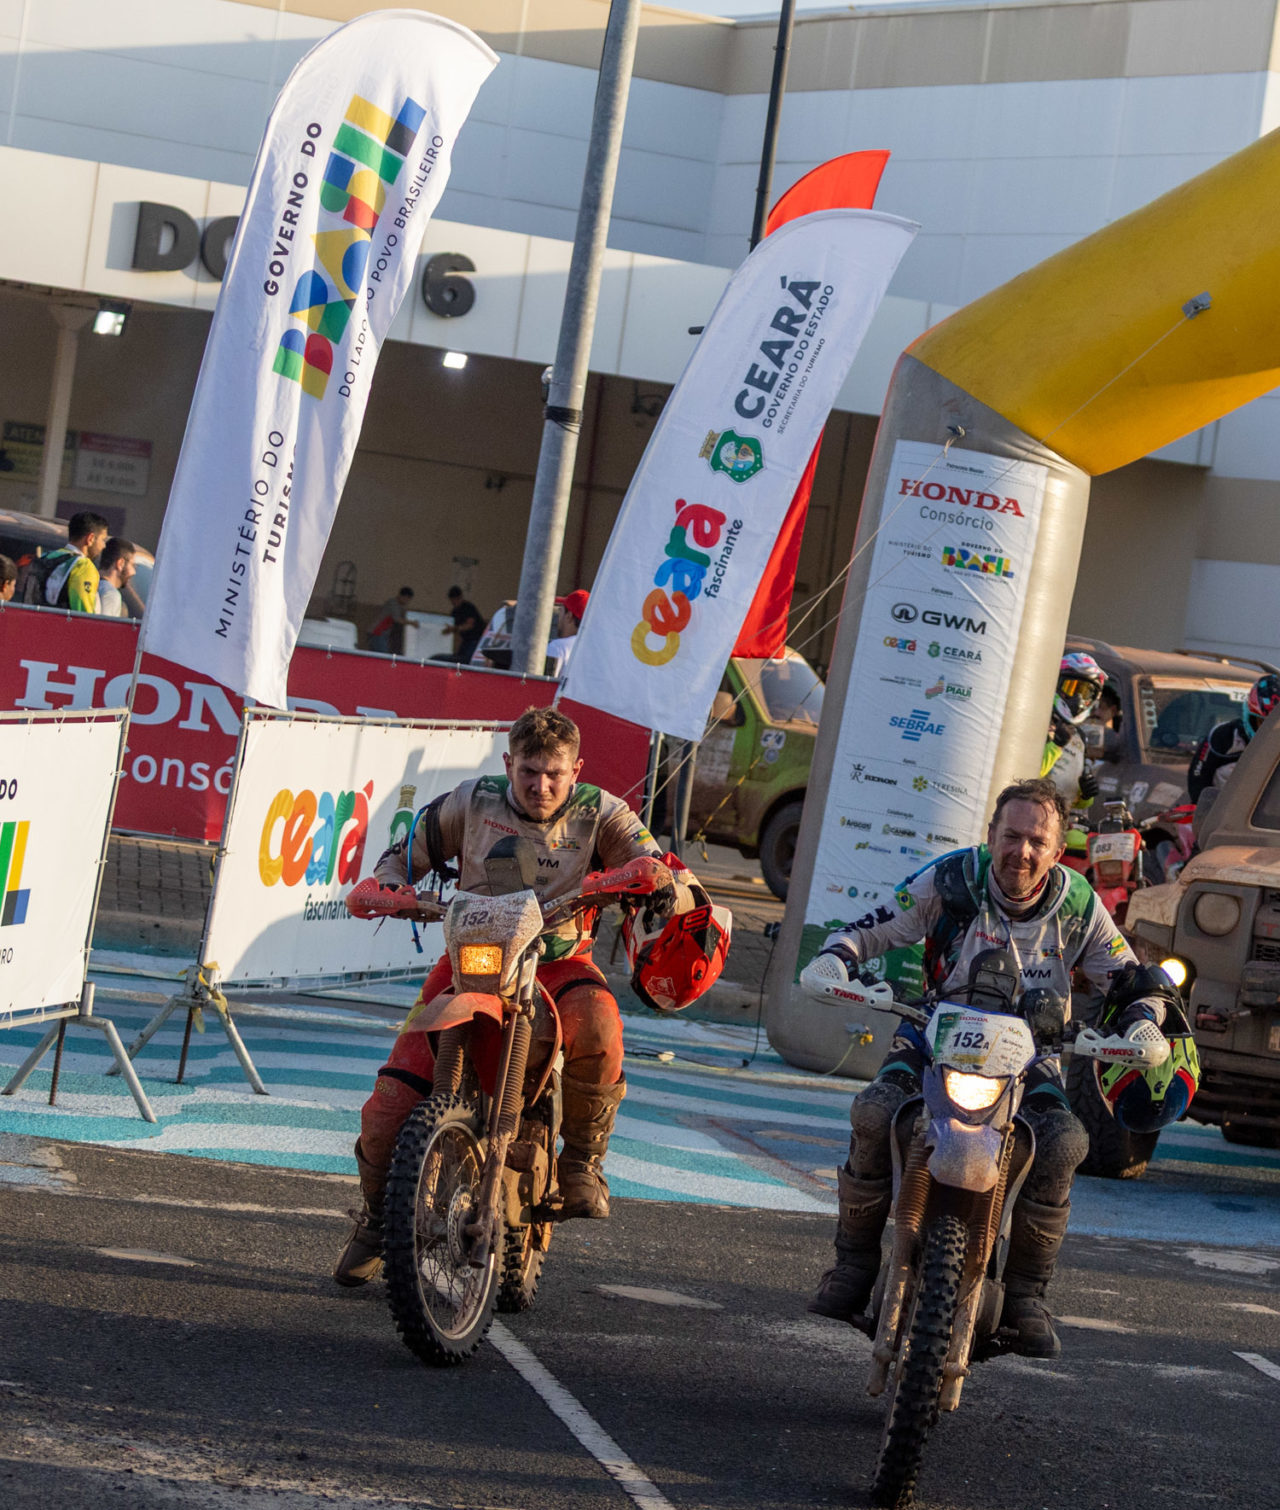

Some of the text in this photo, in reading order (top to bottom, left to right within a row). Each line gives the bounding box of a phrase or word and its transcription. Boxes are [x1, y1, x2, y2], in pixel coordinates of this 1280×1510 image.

[263, 122, 322, 296] GOVERNO DO
[338, 371, 355, 398] DO
[370, 234, 398, 282] POVO
[394, 135, 444, 229] BRASILEIRO
[422, 252, 475, 318] 6
[734, 275, 822, 420] CEARÁ
[762, 284, 834, 429] GOVERNO DO ESTADO
[777, 338, 826, 434] SECRETARIA DO TURISMO
[262, 443, 297, 564] TURISM
[898, 478, 1025, 518] HONDA
[919, 505, 994, 531] Consórcio
[214, 430, 284, 638] MINISTÉRIO DO
[704, 518, 744, 600] fascinante
[921, 609, 987, 635] GWM
[943, 646, 982, 661] CEARÁ
[946, 684, 973, 697] PIAUÍ
[888, 716, 946, 736] SEBRAE
[932, 781, 968, 795] TERESINA
[258, 779, 374, 888] ceará
[484, 818, 519, 836] HONDA
[303, 894, 353, 921] fascinant
